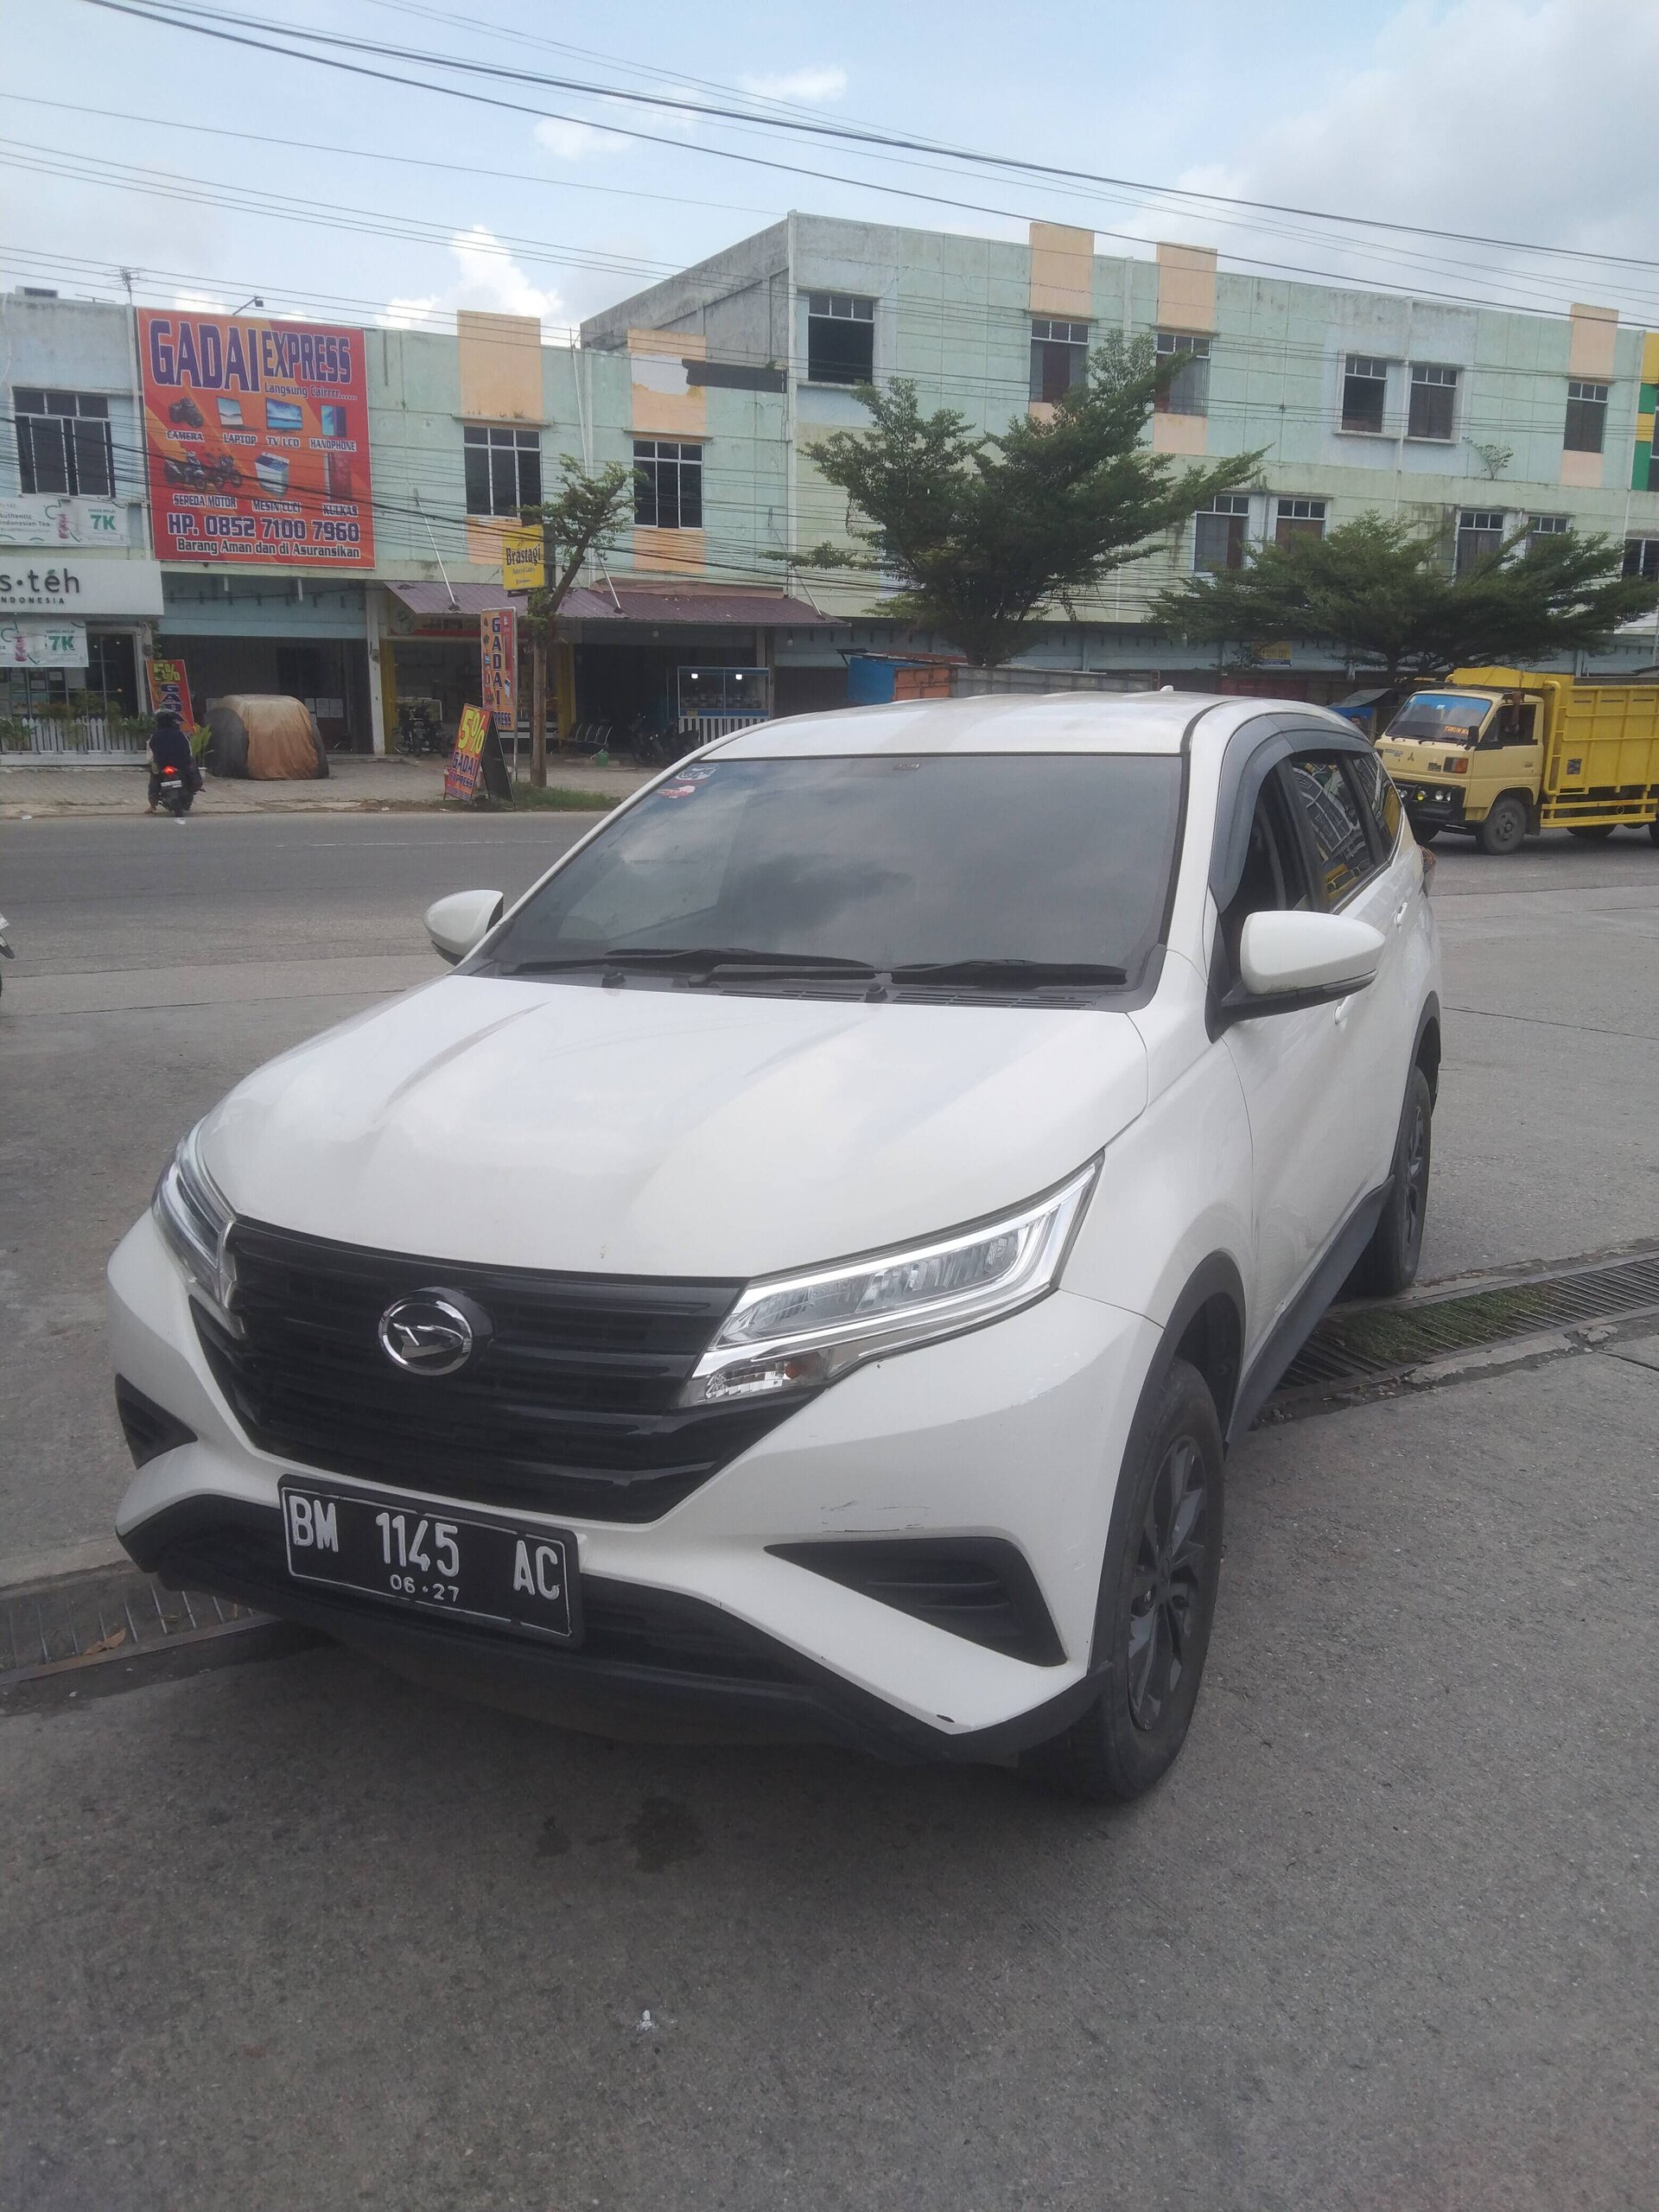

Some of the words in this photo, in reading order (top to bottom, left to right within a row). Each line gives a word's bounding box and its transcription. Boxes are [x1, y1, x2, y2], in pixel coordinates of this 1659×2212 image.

[149, 319, 260, 392] GADAI
[262, 331, 351, 384] EXPRESS
[264, 382, 308, 397] Langsung
[167, 430, 203, 442] CAMERA
[223, 434, 257, 446] LAPTOP
[266, 436, 279, 446] TV
[282, 438, 300, 447] LCD
[310, 438, 356, 451] HANDPHONE
[174, 494, 206, 506] SEPEDA
[207, 496, 237, 508] MOTOR
[252, 500, 280, 512] MESIN
[90, 514, 117, 531] 7K
[168, 514, 199, 535] HP.
[206, 516, 256, 537] 0852
[262, 518, 306, 540] 7100
[177, 537, 218, 555] Barang
[220, 540, 252, 554] Aman
[256, 542, 276, 555] dan
[279, 543, 289, 556] di
[291, 543, 360, 559] Asuransikan
[506, 543, 541, 566] Brastagi
[48, 636, 75, 651] 7K
[492, 617, 503, 705] GADAI
[153, 663, 181, 681] 5%
[457, 709, 485, 755] 5%
[453, 751, 478, 776] GADAI
[289, 1495, 339, 1553] BM
[376, 1512, 459, 1578] 1145
[513, 1540, 560, 1599] AC
